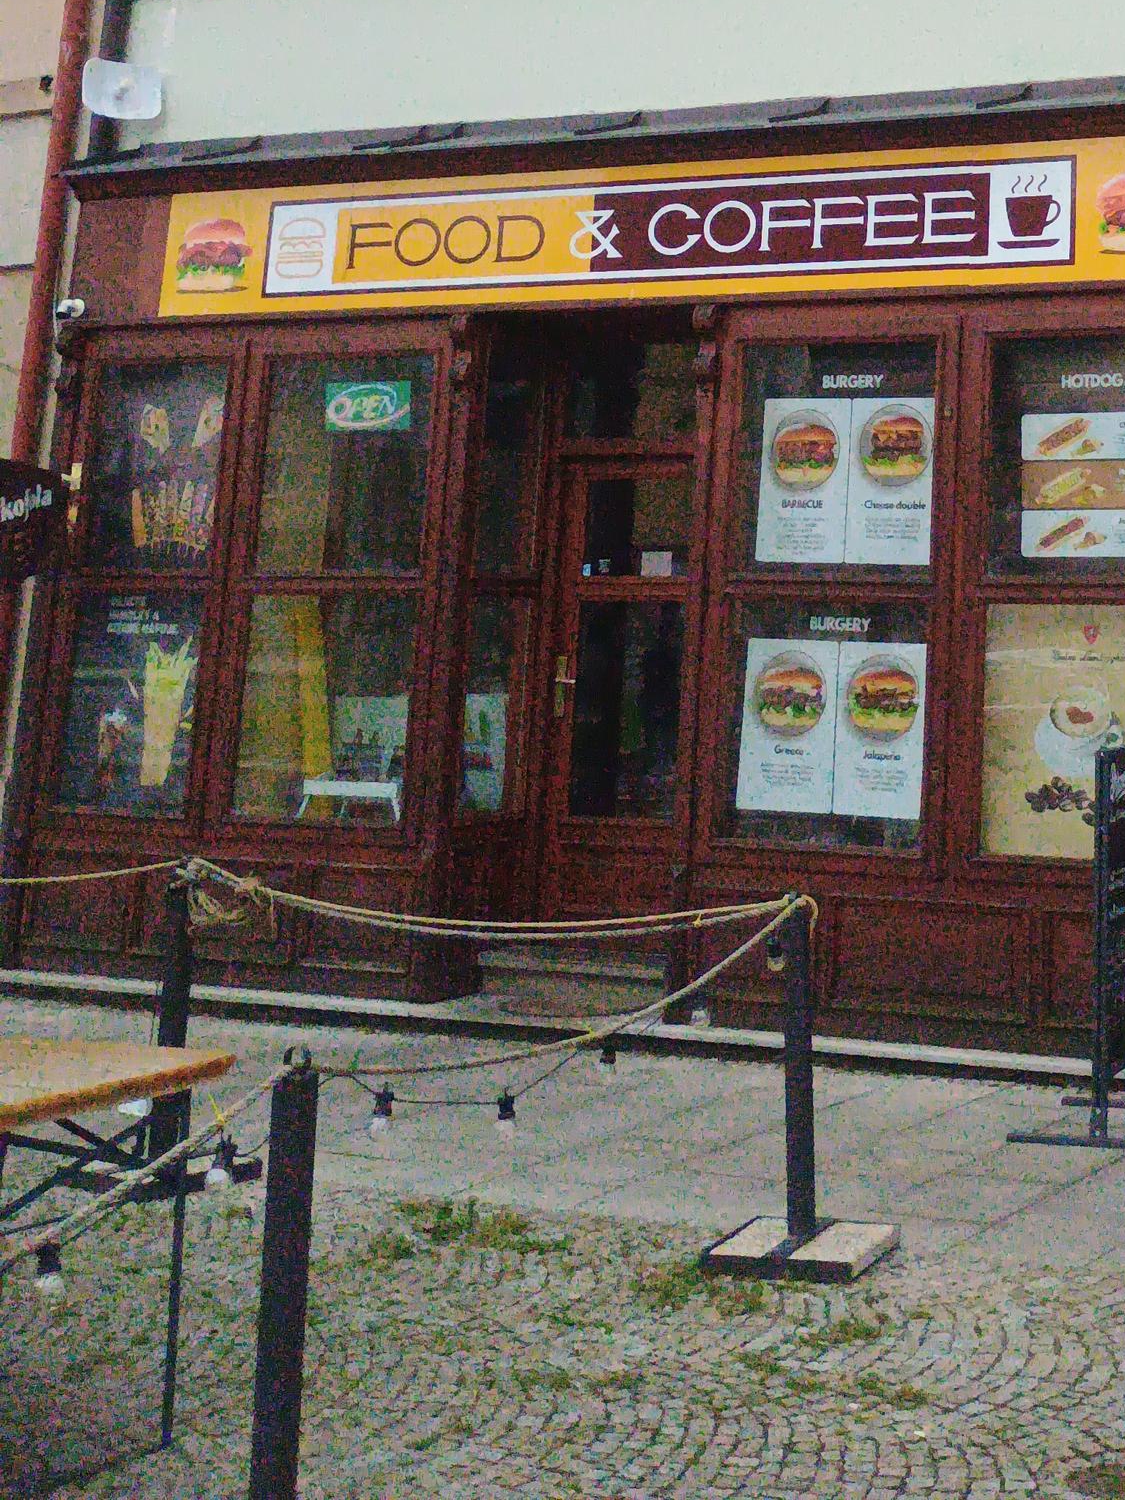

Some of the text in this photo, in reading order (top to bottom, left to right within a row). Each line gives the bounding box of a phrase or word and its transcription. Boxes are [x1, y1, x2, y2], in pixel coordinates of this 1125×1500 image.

[346, 190, 977, 270] FOOD & COFFEE
[822, 374, 884, 389] BURGERY
[1061, 373, 1124, 389] HOTDOG
[329, 395, 396, 421] OPEN
[781, 499, 823, 509] BARBECUE
[895, 499, 926, 510] double
[809, 616, 872, 632] BURGERY
